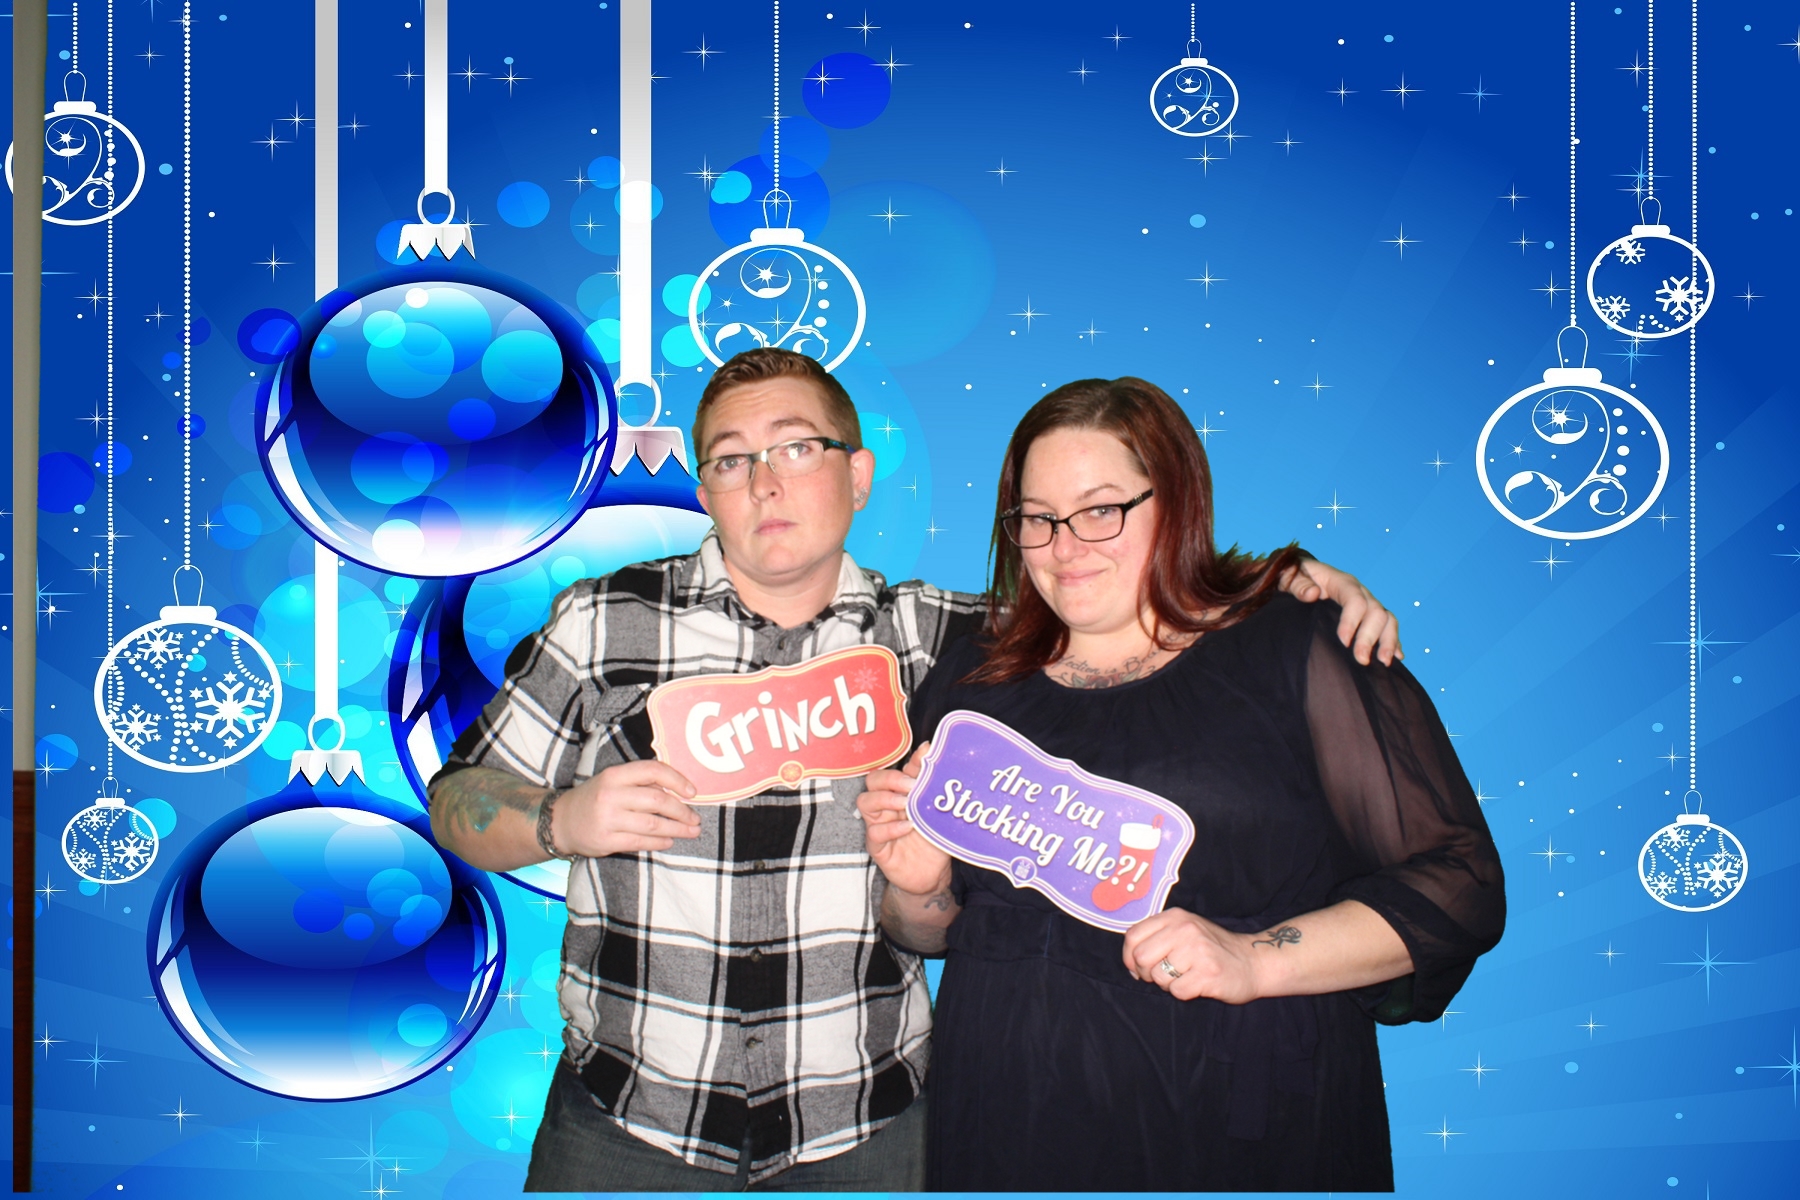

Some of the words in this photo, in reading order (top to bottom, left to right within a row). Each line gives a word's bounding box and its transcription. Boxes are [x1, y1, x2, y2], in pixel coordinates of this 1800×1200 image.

[685, 674, 876, 773] Grinch
[933, 778, 1064, 867] Stocking
[1067, 836, 1150, 893] Me?!
[989, 765, 1043, 803] Are
[1050, 784, 1105, 830] You
